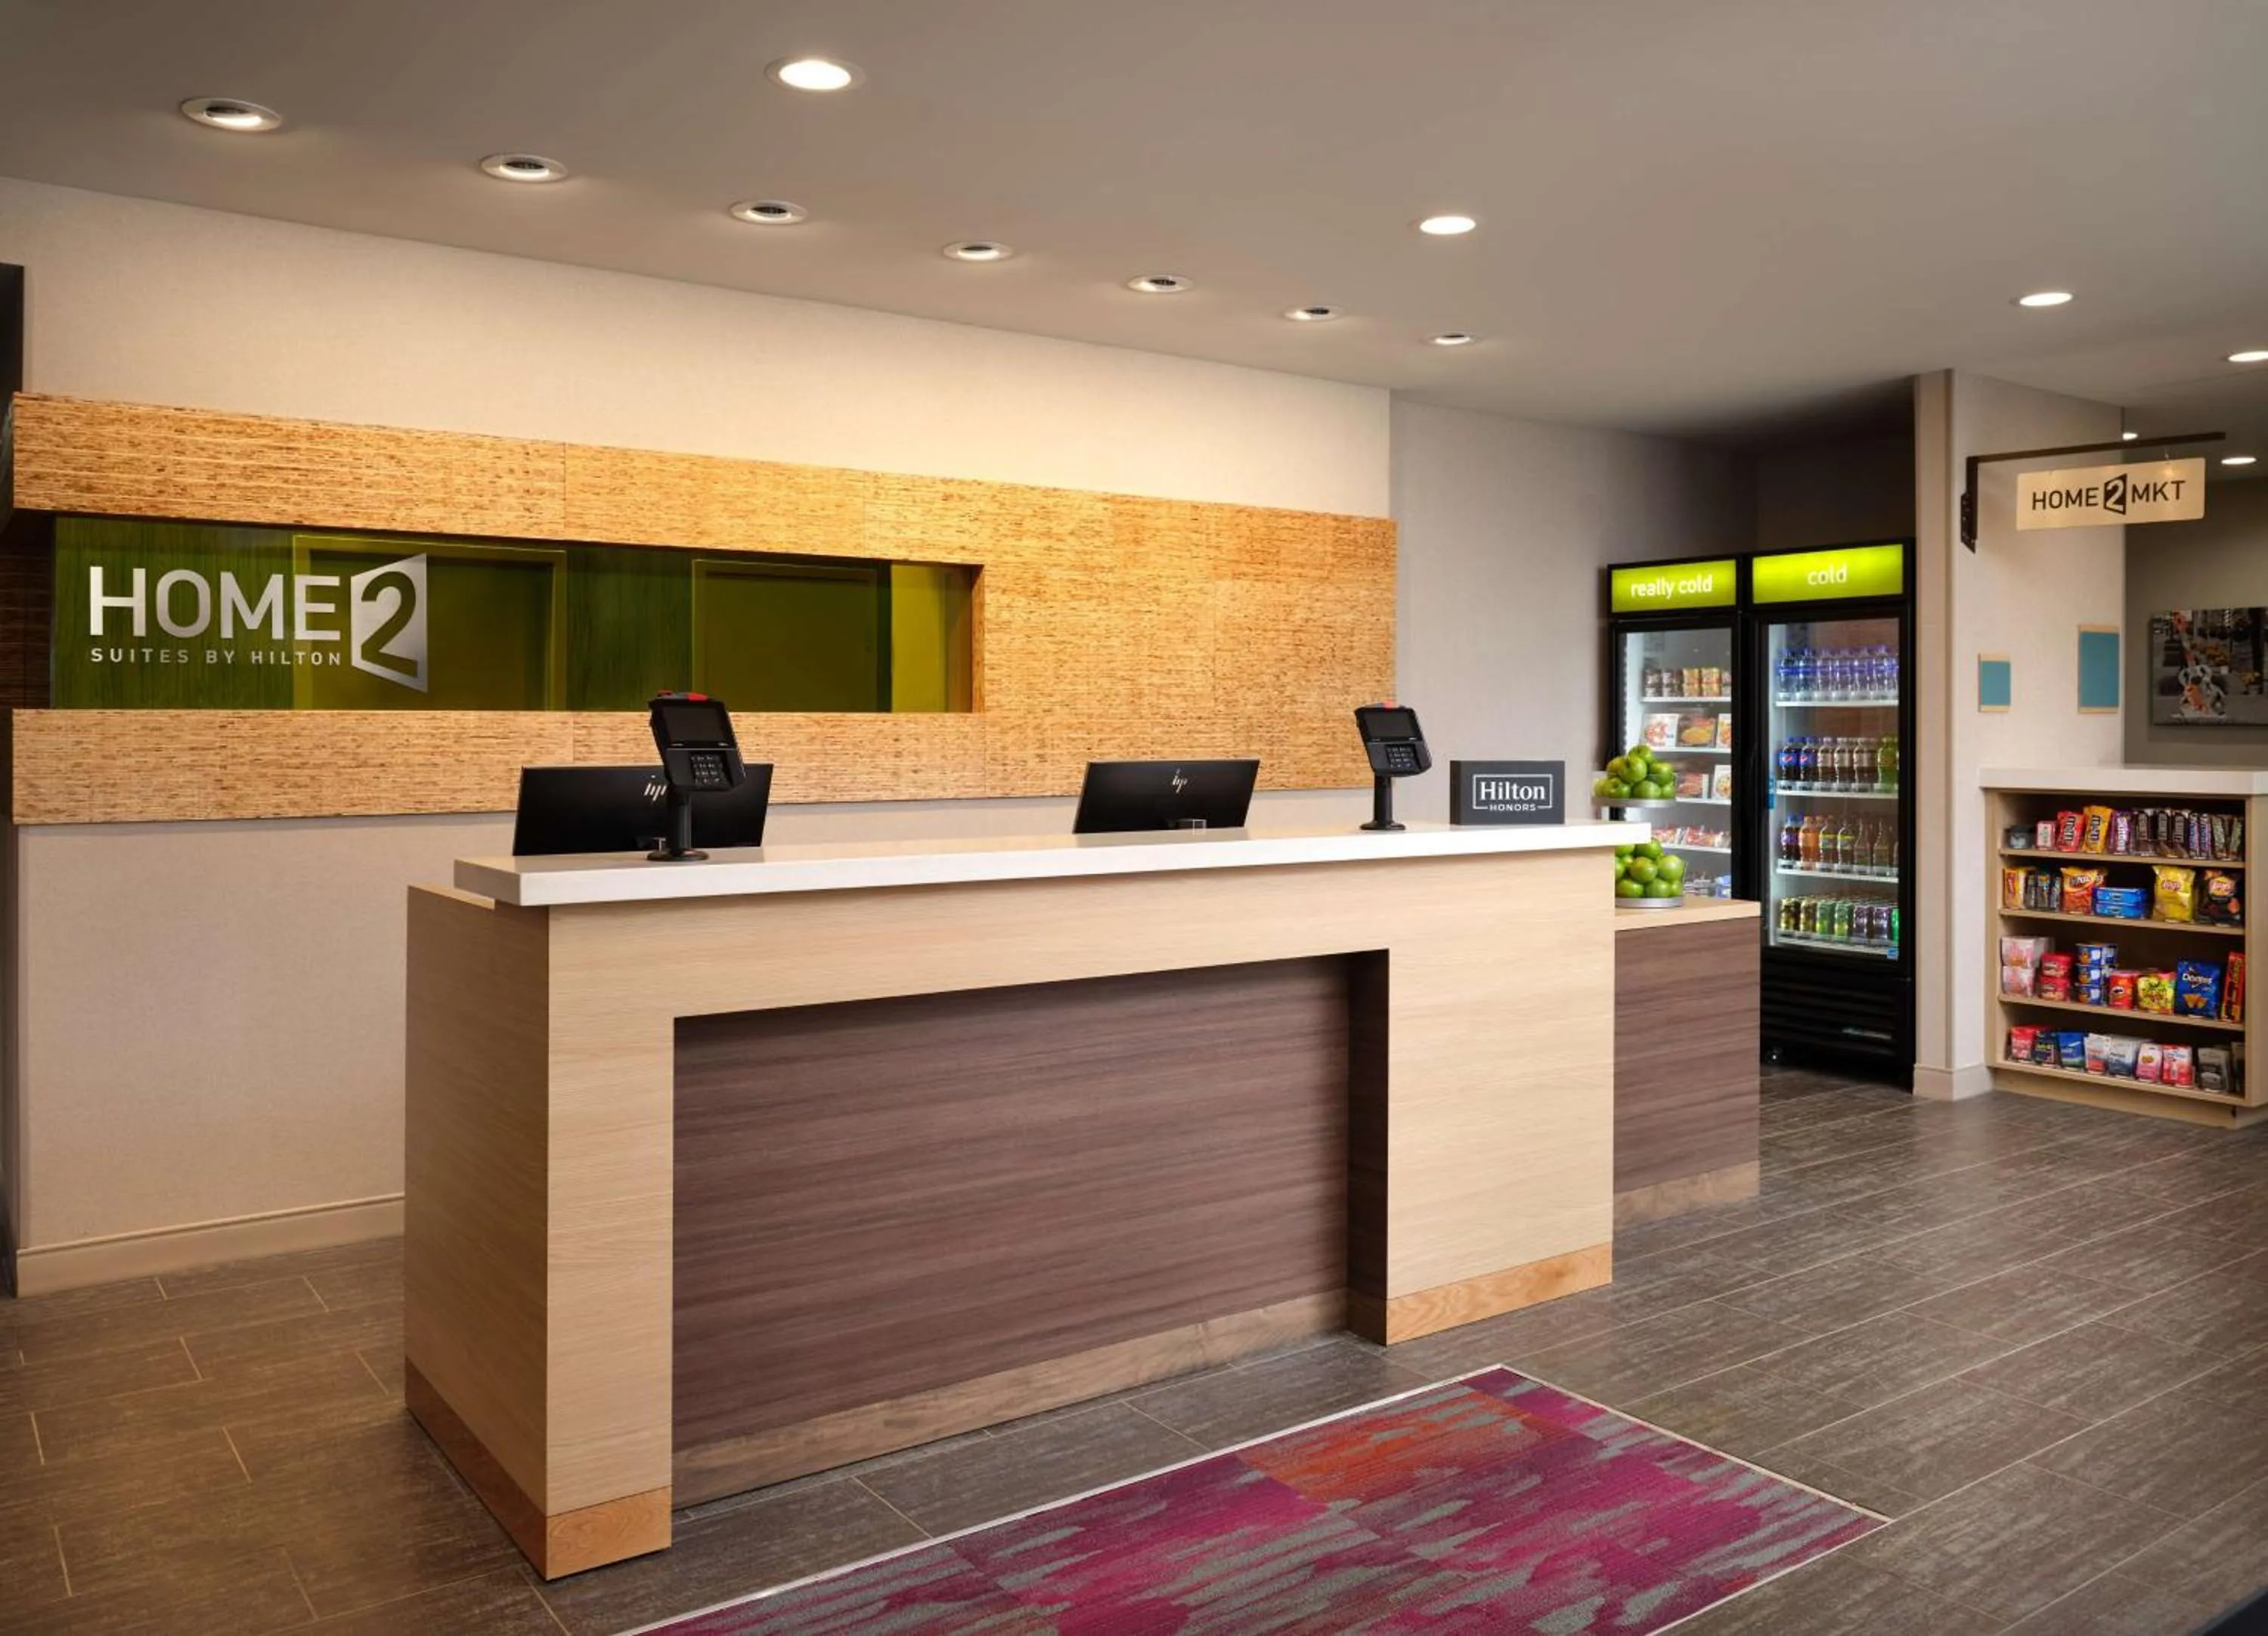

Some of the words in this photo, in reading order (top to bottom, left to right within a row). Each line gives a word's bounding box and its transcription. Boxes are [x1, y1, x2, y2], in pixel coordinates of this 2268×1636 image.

[1808, 562, 1847, 585] cold
[1631, 577, 1675, 600] really
[1678, 574, 1713, 593] cold
[91, 647, 189, 663] SUITES
[206, 649, 235, 664] BY
[252, 651, 340, 665] HILTON
[1479, 781, 1545, 800] Hilton
